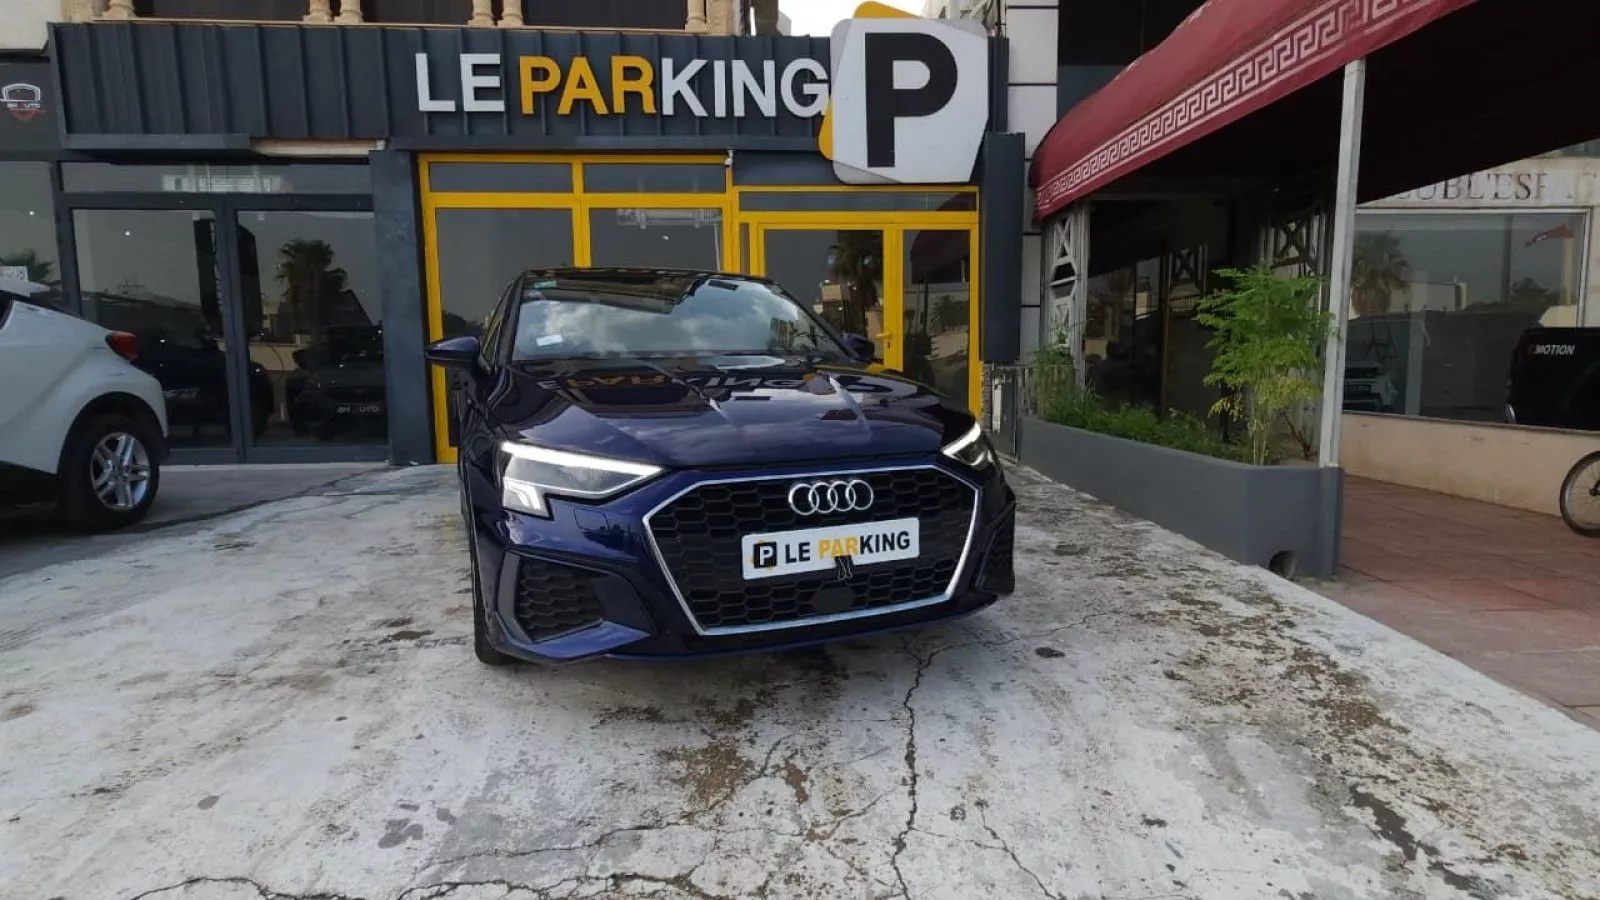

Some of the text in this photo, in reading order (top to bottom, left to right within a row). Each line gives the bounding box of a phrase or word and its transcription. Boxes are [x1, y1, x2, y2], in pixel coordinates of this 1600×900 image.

[415, 52, 830, 118] LE PARKING
[864, 33, 959, 168] P
[785, 542, 811, 564] LE
[817, 531, 911, 560] PARKING
